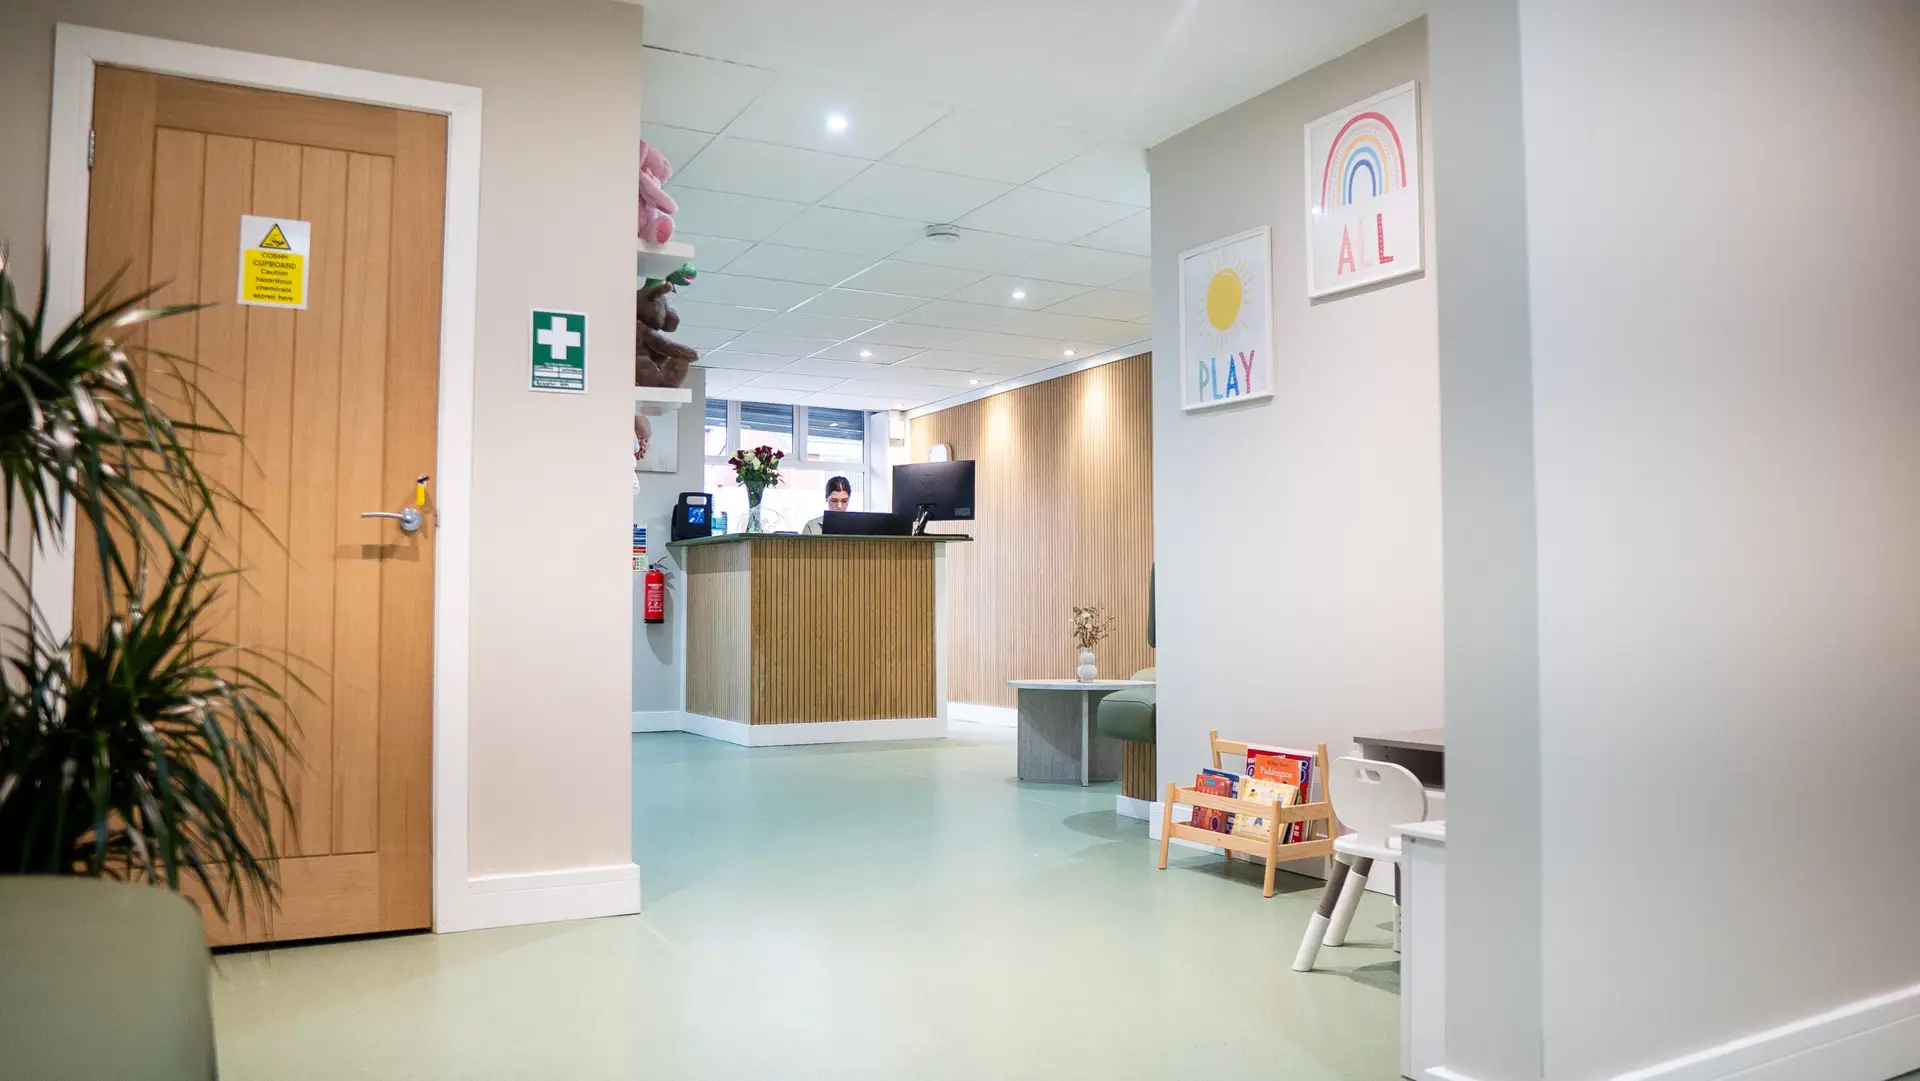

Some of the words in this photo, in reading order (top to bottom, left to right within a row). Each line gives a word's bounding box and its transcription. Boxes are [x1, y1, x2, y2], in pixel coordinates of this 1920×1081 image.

[1337, 213, 1394, 275] ALL
[253, 260, 296, 270] CUPBOARD
[260, 268, 288, 276] Caution
[255, 277, 292, 285] hazardous
[255, 284, 292, 293] chemicals
[278, 294, 294, 302] here
[1199, 349, 1255, 403] PLAY
[1259, 765, 1293, 779] Paddington
